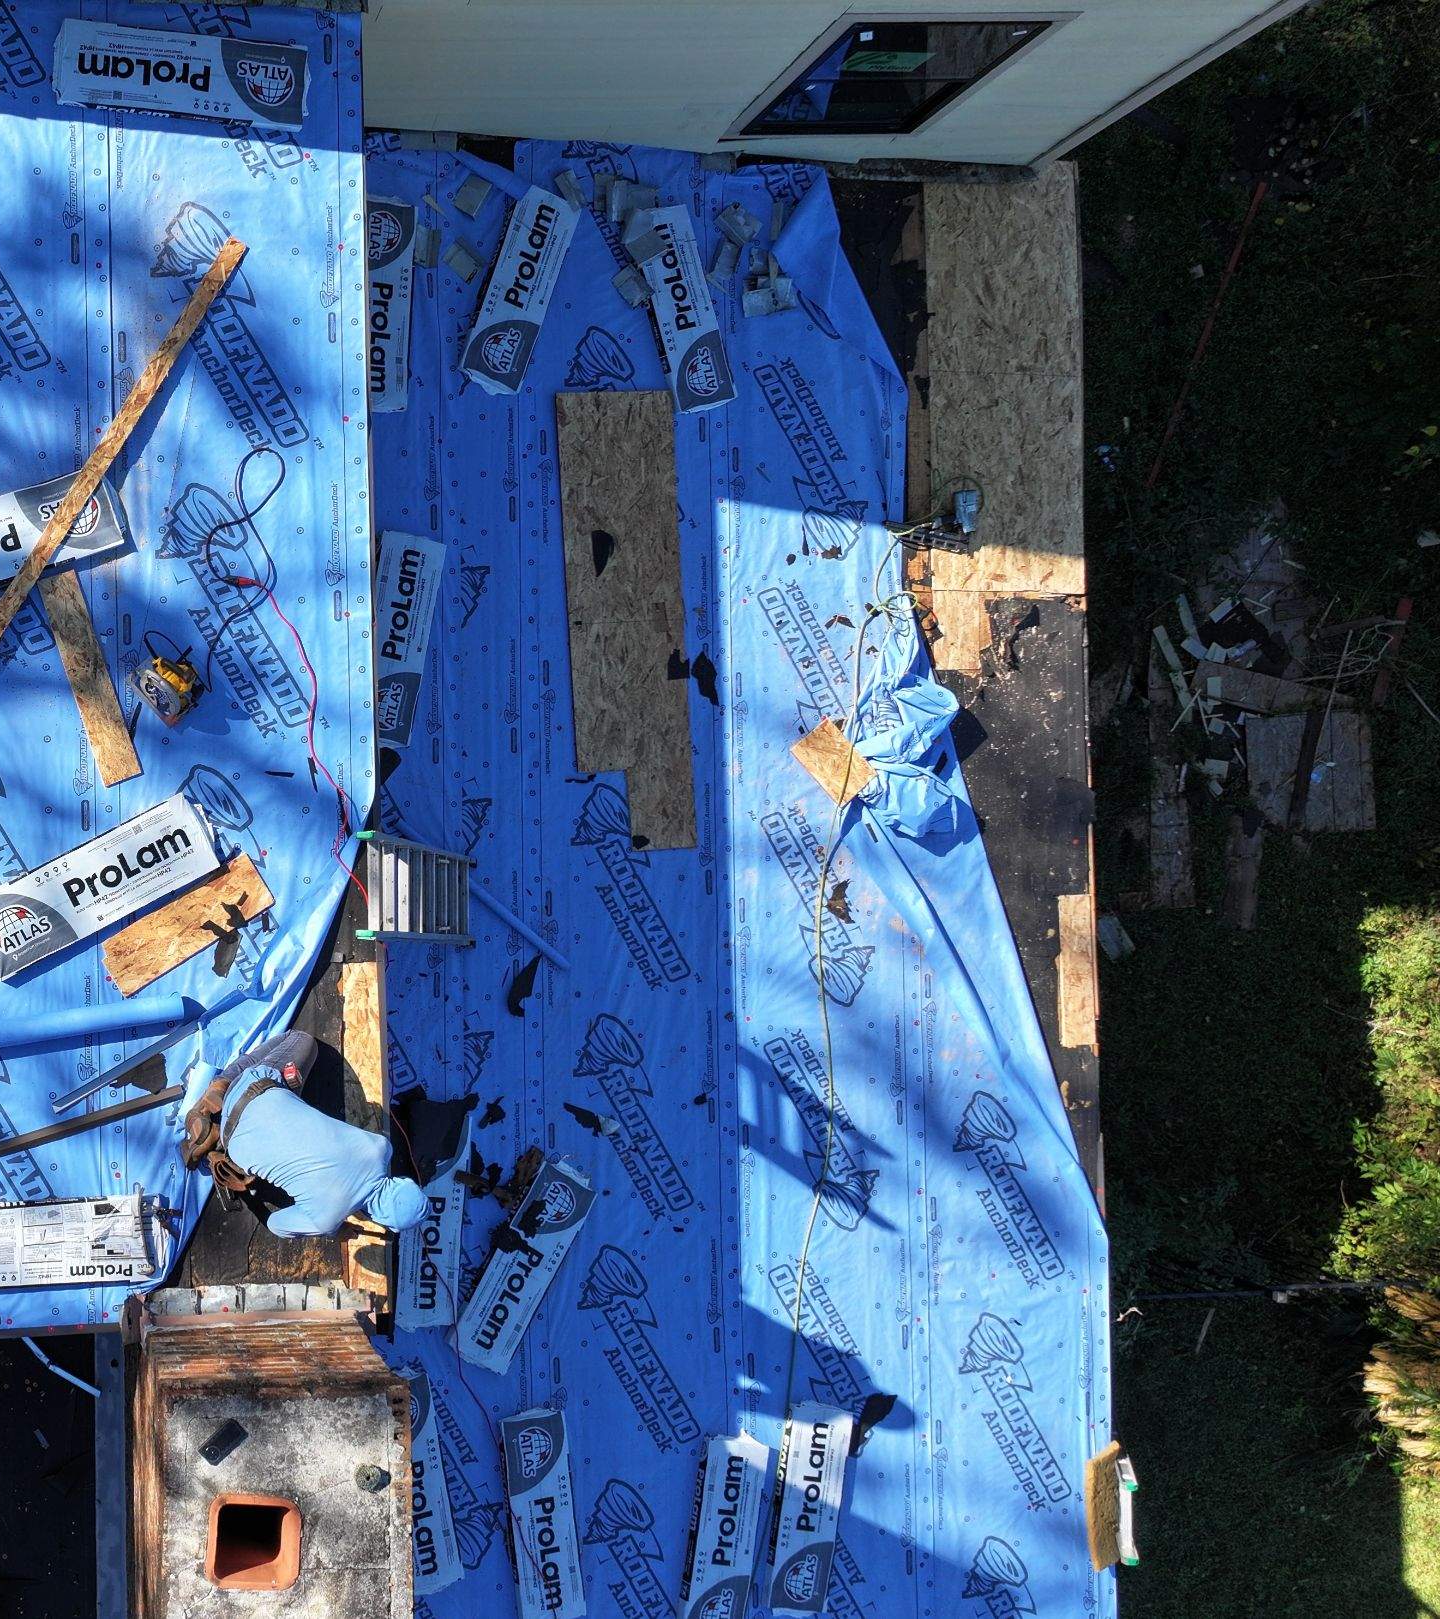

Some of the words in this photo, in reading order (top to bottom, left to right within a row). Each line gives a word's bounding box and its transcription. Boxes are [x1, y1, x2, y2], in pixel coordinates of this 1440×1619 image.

[78, 52, 210, 93] ProLam
[237, 61, 289, 82] ATLAS
[370, 214, 382, 260] ATLAS
[504, 203, 556, 310] ProLam
[190, 276, 310, 447] OOFNADO
[370, 282, 394, 394] ProLam
[499, 329, 520, 374] ATLAS
[698, 348, 718, 392] ATLAS
[753, 364, 846, 505] ROOFNADO
[780, 357, 847, 462] AnchorDeck
[381, 549, 421, 662] ProLam
[785, 579, 850, 686] AnchorDeck
[385, 683, 403, 728] ATLAS
[63, 828, 192, 907] ProLam
[595, 839, 691, 983] ROOFNADO
[2, 916, 52, 952] ATLAS
[594, 883, 663, 992] AnchorDeck
[598, 1070, 694, 1213] ROOFNADO
[609, 1130, 666, 1221] nchorDeck
[974, 1144, 1065, 1280] ROOFNADO
[976, 1187, 1040, 1291] AnchorDeck
[70, 1263, 133, 1278] ProLam
[475, 1247, 545, 1352] ProLam
[603, 1301, 701, 1445] ROOFNADO
[604, 1347, 674, 1455] AnchorDeck
[519, 1432, 536, 1478] ATLAS
[795, 1421, 830, 1533] ProLam
[981, 1409, 1046, 1513] AnchorDeck
[982, 1365, 1071, 1503] ROOFNADO
[533, 1496, 562, 1611] ProLam
[711, 1455, 744, 1567] ProLam
[801, 1555, 818, 1598] ATLAS
